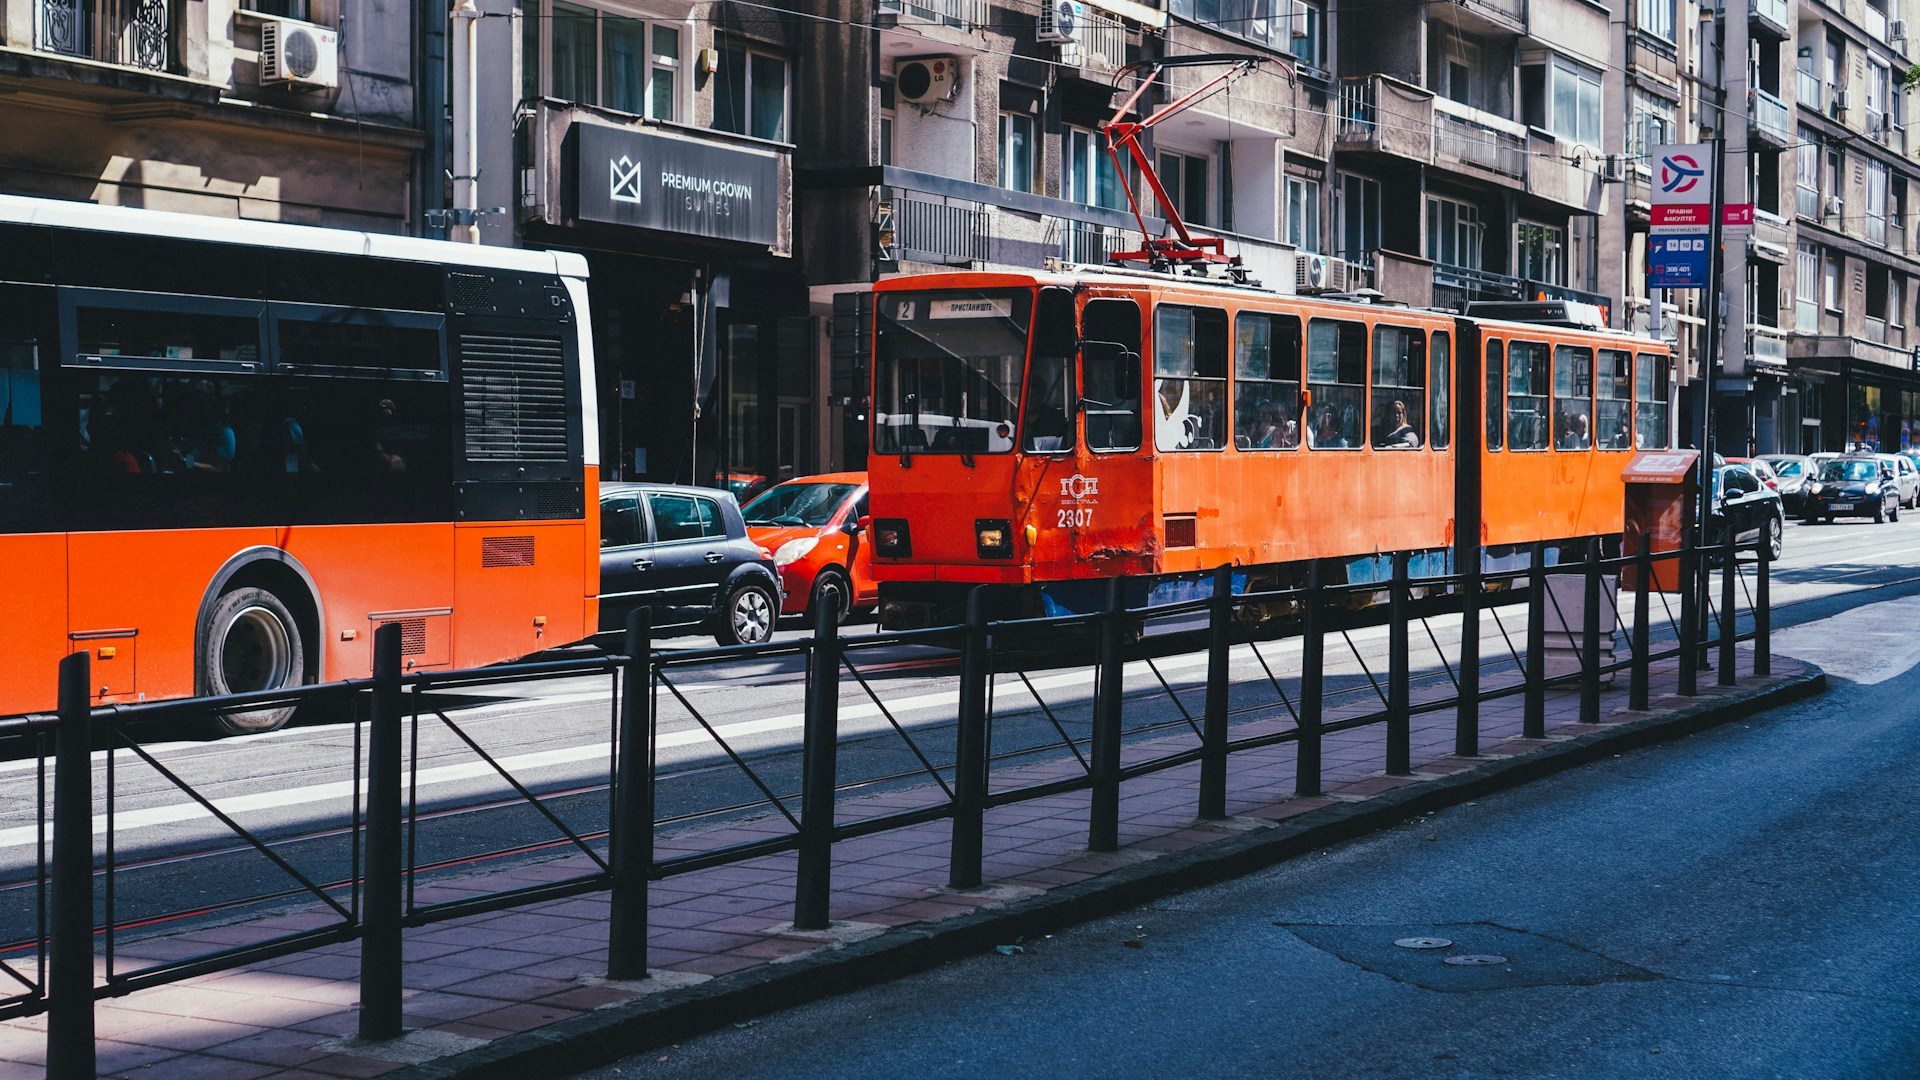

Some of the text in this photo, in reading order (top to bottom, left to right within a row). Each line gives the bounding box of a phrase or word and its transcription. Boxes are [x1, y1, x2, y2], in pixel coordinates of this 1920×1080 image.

[661, 171, 752, 200] PREMIUM CROWN
[685, 196, 730, 217] SUITES
[1741, 208, 1749, 221] 1
[902, 302, 910, 319] 2
[950, 303, 992, 312] ПРИСТАНИШТЕ
[1057, 508, 1093, 528] 2307
